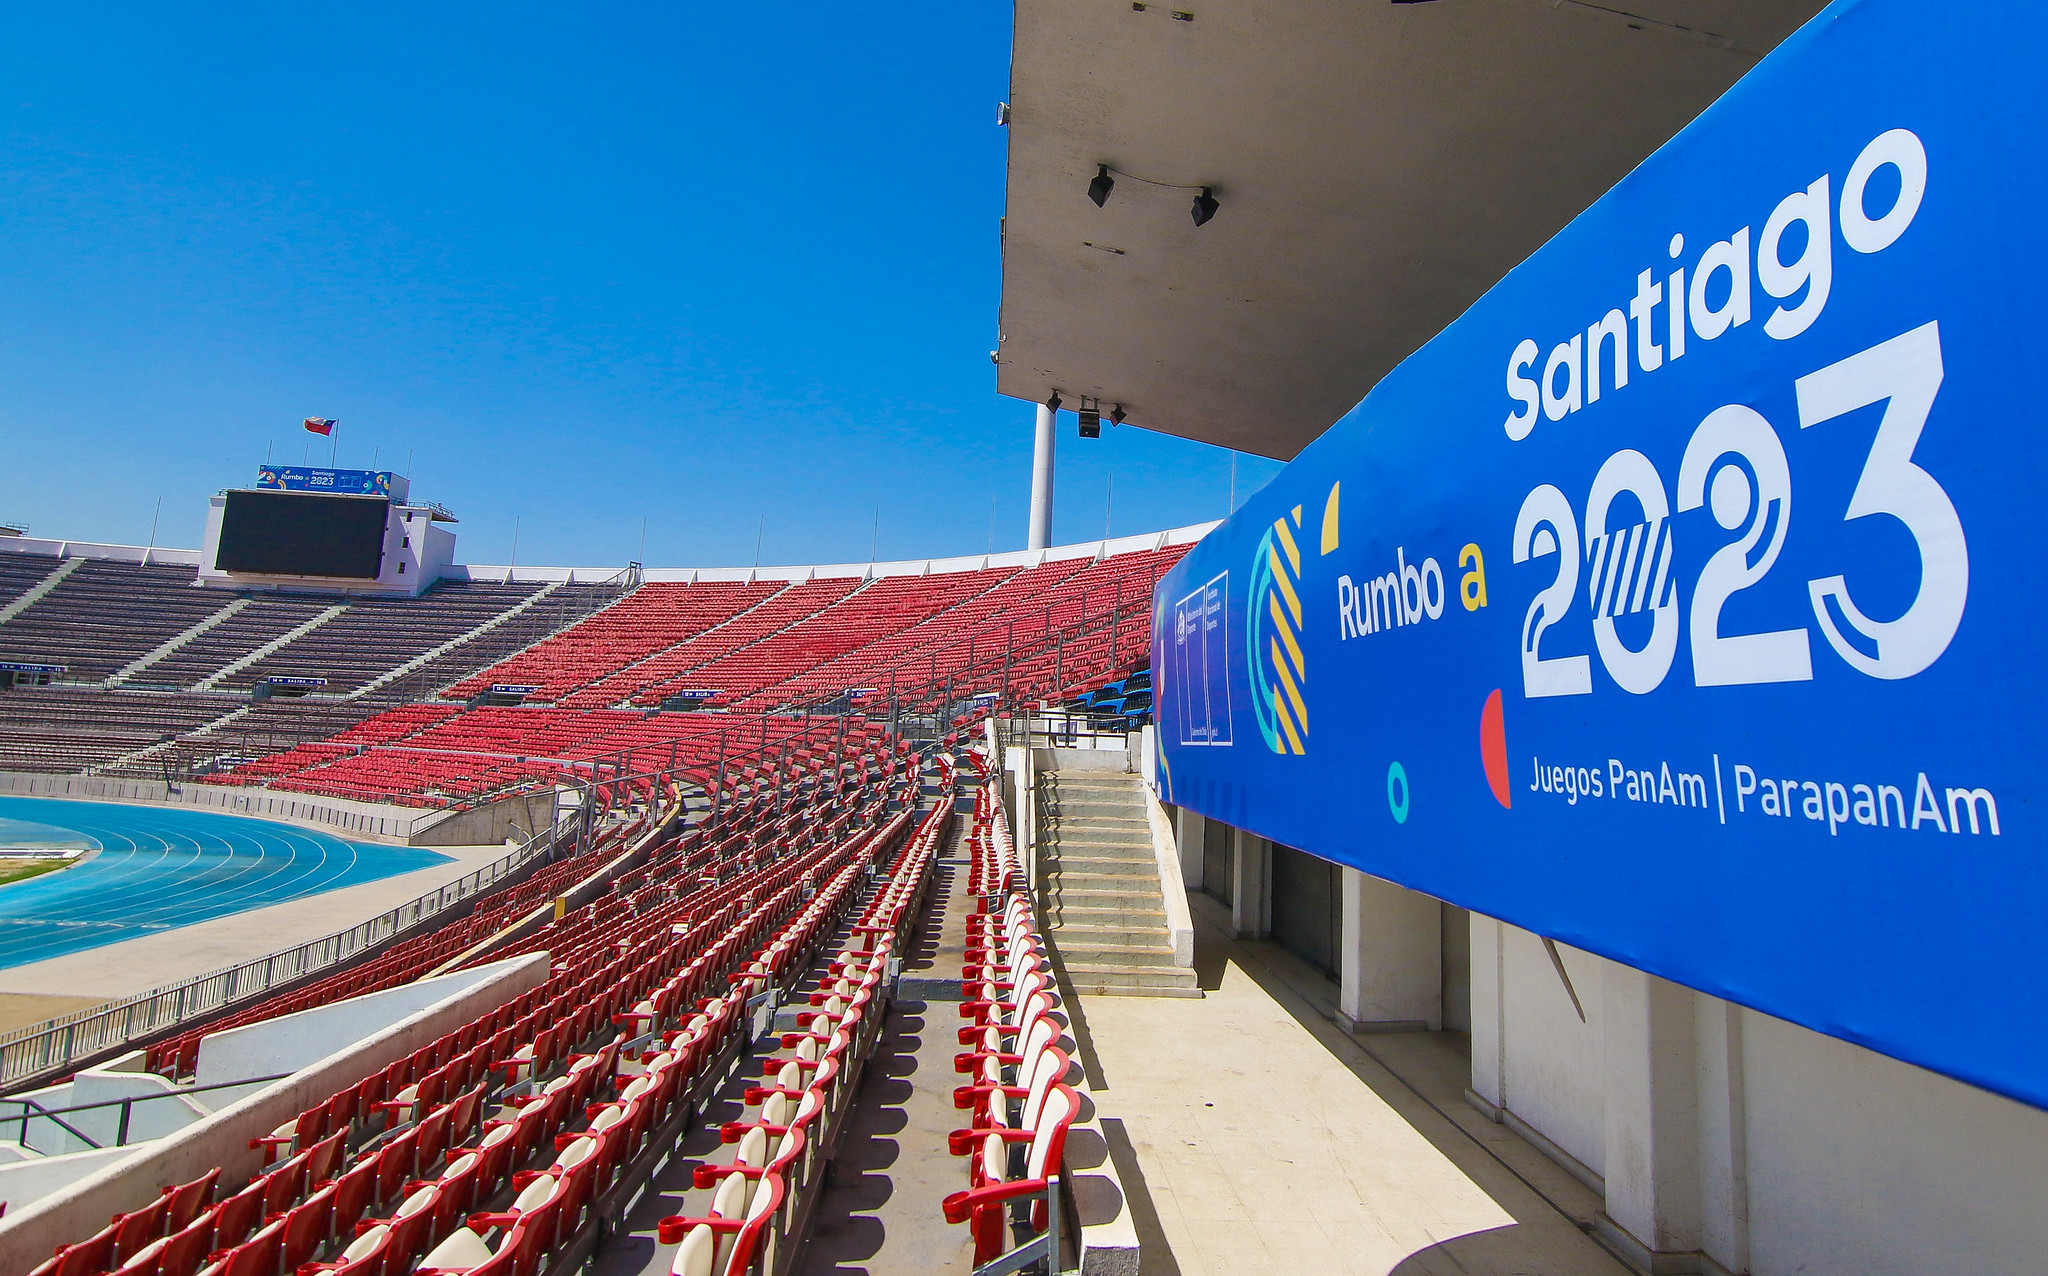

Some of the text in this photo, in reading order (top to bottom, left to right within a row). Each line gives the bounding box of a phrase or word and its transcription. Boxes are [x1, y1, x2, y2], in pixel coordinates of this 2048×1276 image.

[1504, 127, 1928, 442] Santiago
[310, 476, 334, 486] 2023
[1512, 318, 1970, 698] 2023
[1337, 542, 1488, 641] Rumbo a
[1530, 755, 1603, 806] Juegos
[1608, 758, 1708, 809] PanAm
[1734, 763, 2001, 837] ParapanAm
